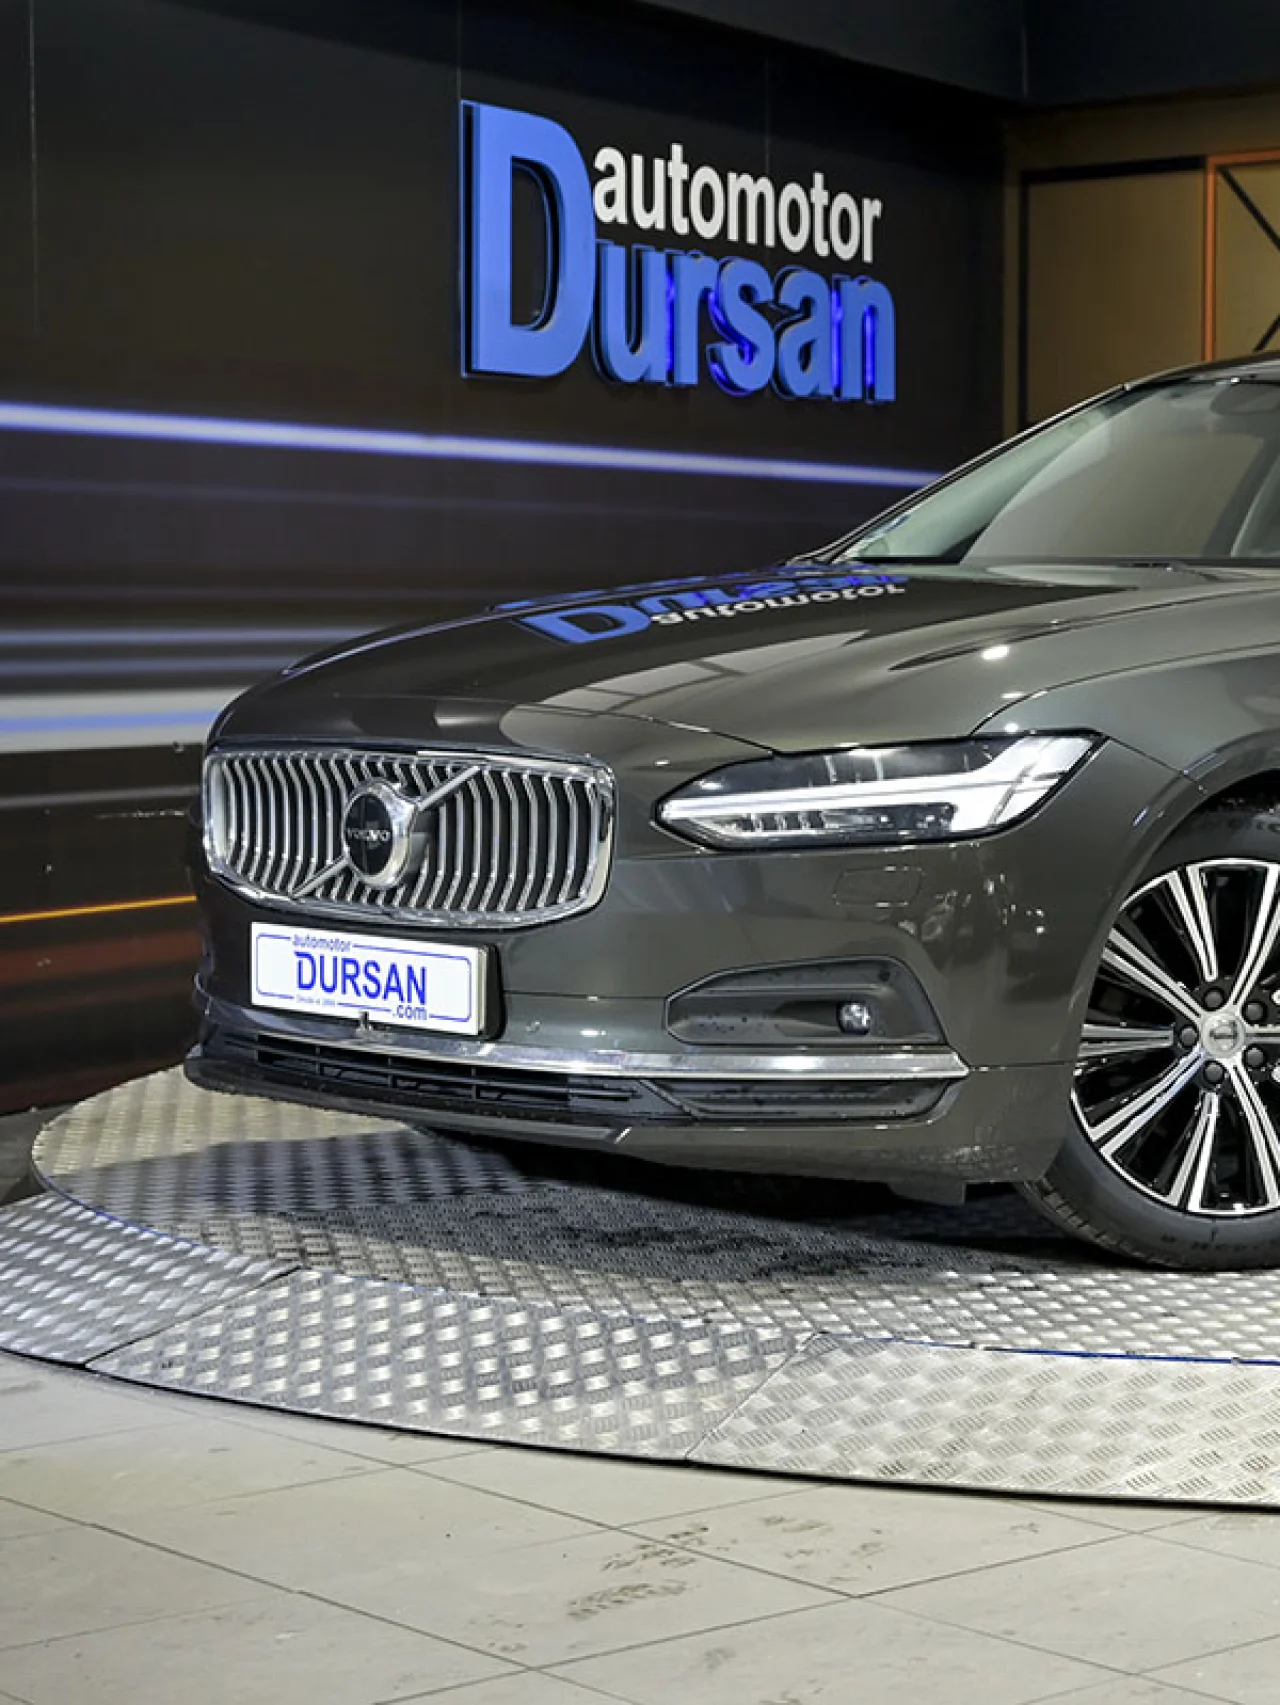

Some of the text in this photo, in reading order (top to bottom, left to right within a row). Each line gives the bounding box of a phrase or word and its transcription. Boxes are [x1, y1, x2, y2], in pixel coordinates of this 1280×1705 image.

[593, 142, 882, 264] automotor
[461, 99, 897, 403] Dursan
[346, 827, 391, 842] VOLVO
[292, 933, 352, 953] automotor
[294, 951, 427, 1006] DURSAN
[392, 1004, 427, 1021] .com
